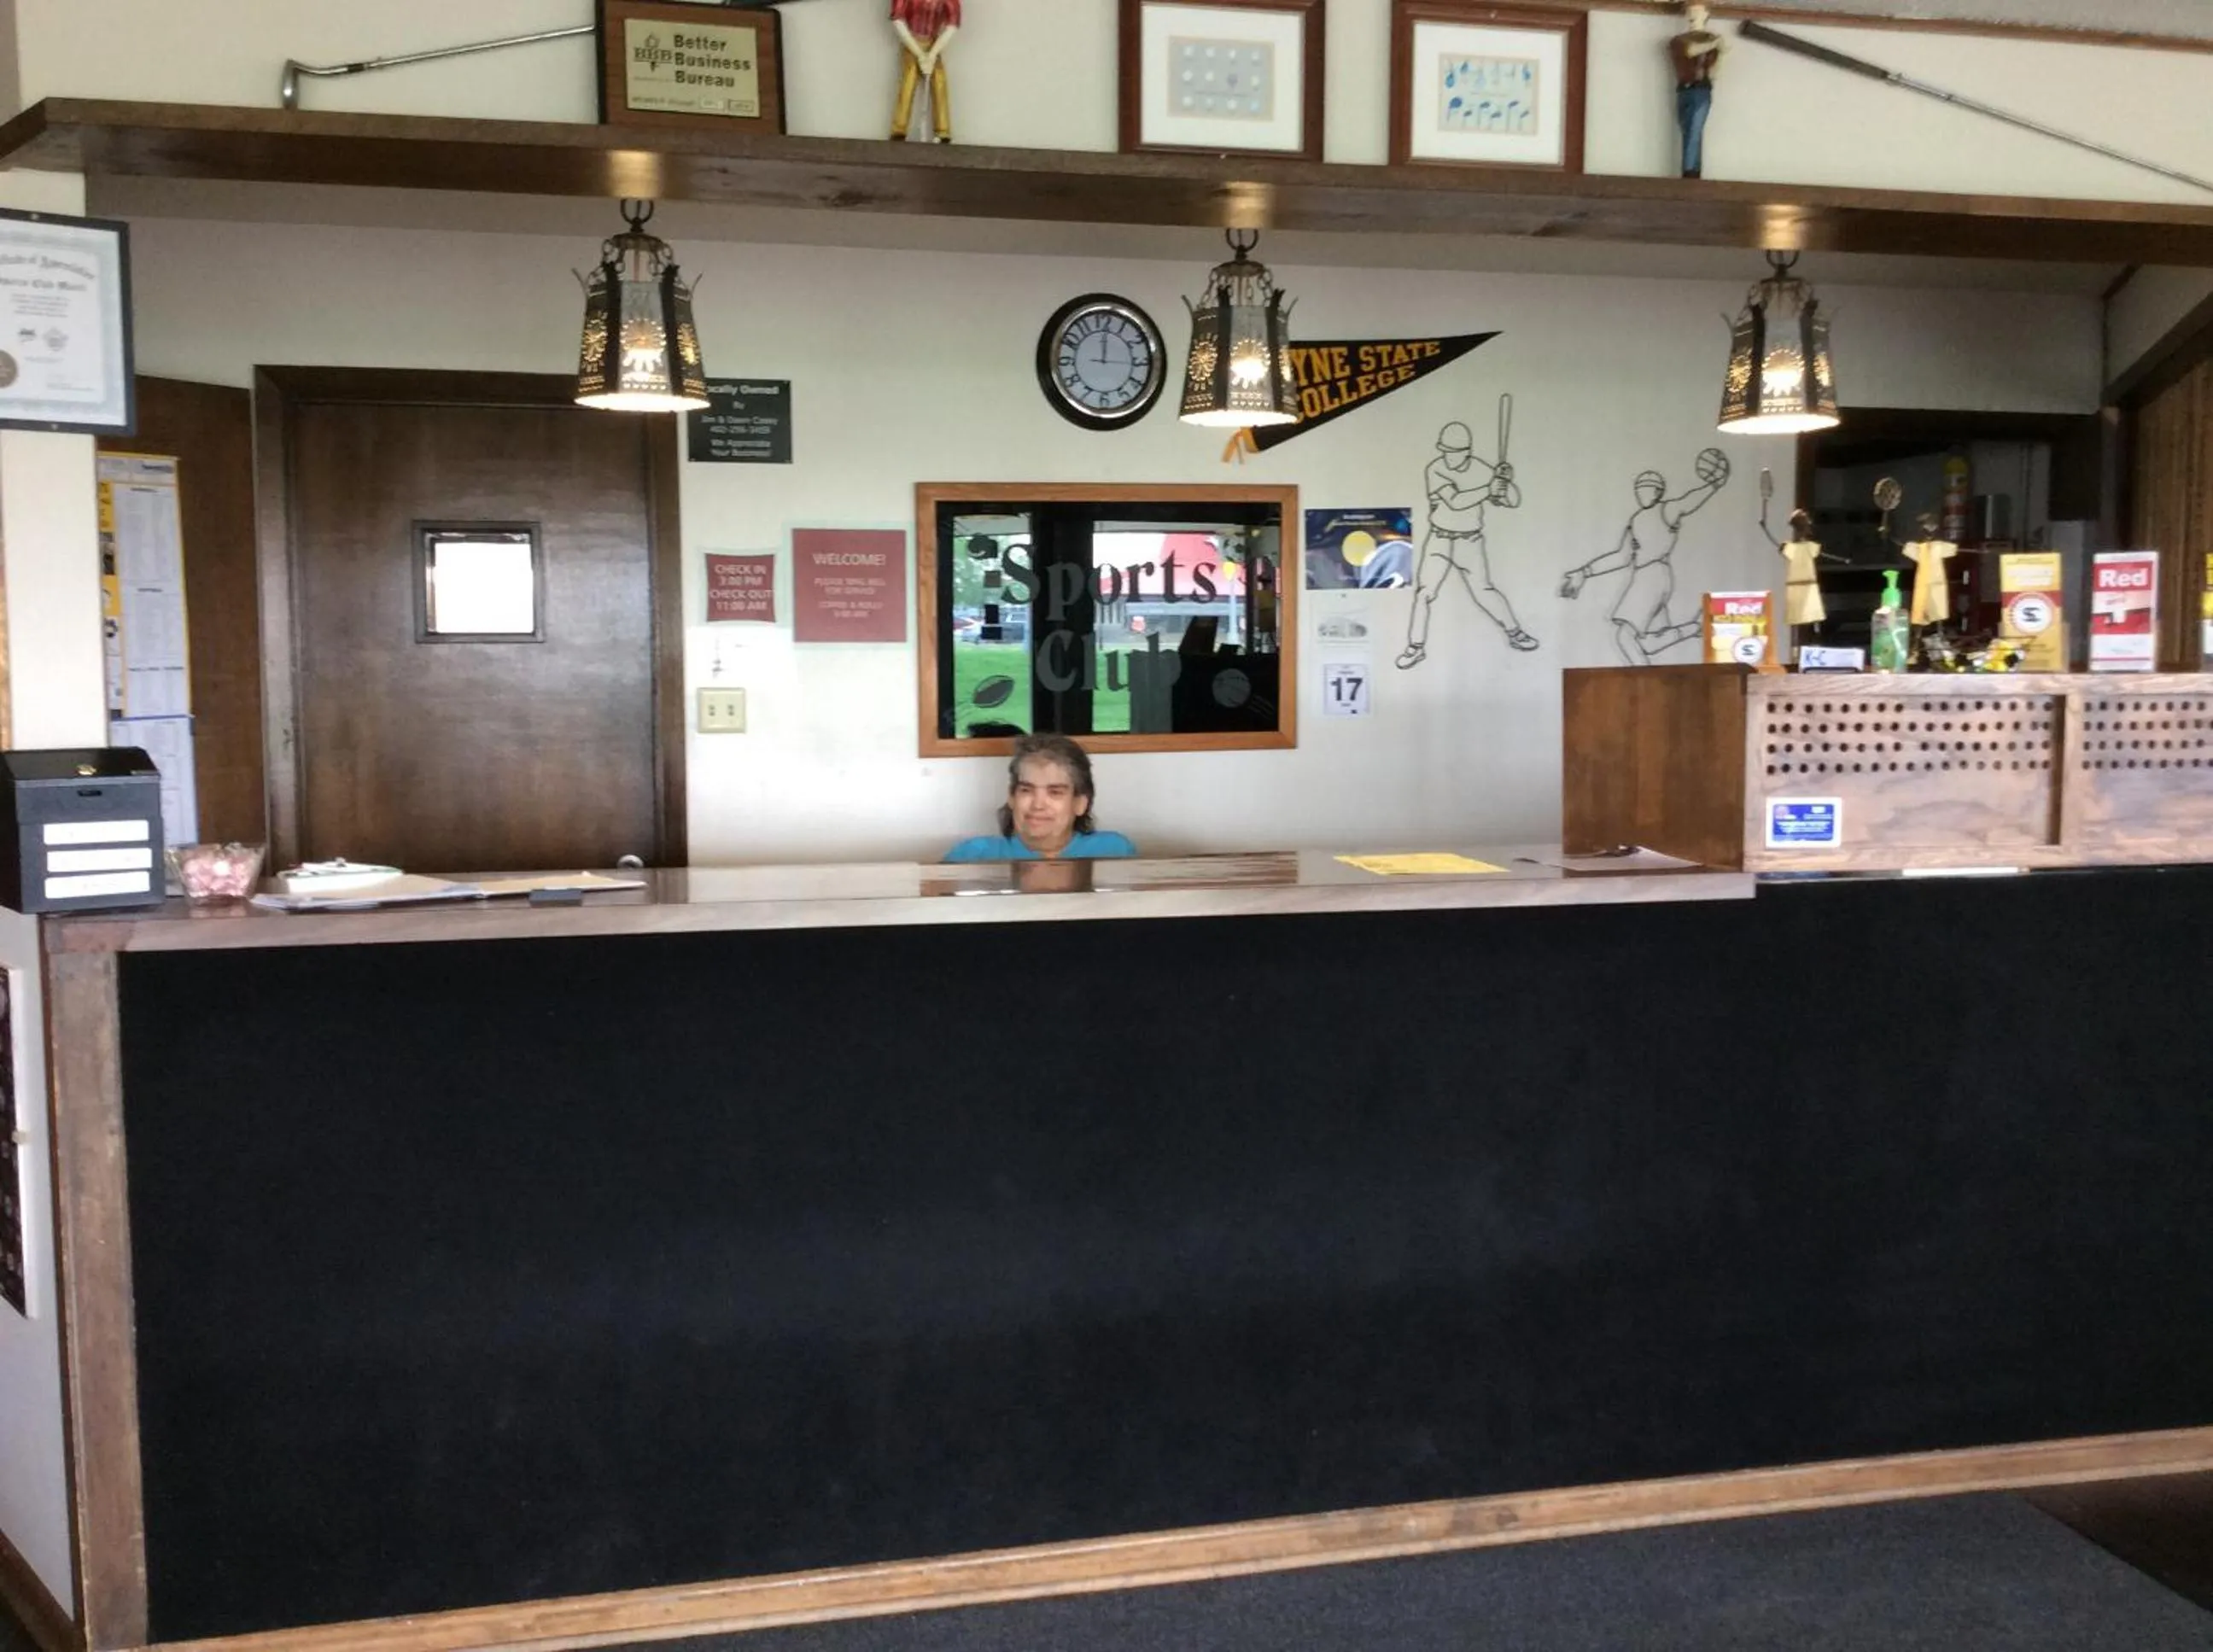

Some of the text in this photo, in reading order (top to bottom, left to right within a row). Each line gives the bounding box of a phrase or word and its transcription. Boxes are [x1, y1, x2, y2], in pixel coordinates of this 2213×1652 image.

[674, 34, 727, 52] Better
[674, 52, 751, 71] Business
[674, 71, 735, 87] Bureau
[1288, 341, 1440, 387] YNE STATE
[706, 385, 739, 395] ocally
[1297, 365, 1416, 423] OLLEGE
[714, 564, 767, 575] CHECK IN
[2099, 567, 2150, 587] Red
[744, 575, 763, 586] PM
[1001, 542, 1217, 622] Sports
[709, 589, 774, 599] CHECK OUT
[716, 601, 768, 611] 11:00 AM
[1725, 602, 1763, 616] Red
[1036, 628, 1182, 692] Club
[1331, 677, 1363, 701] 17
